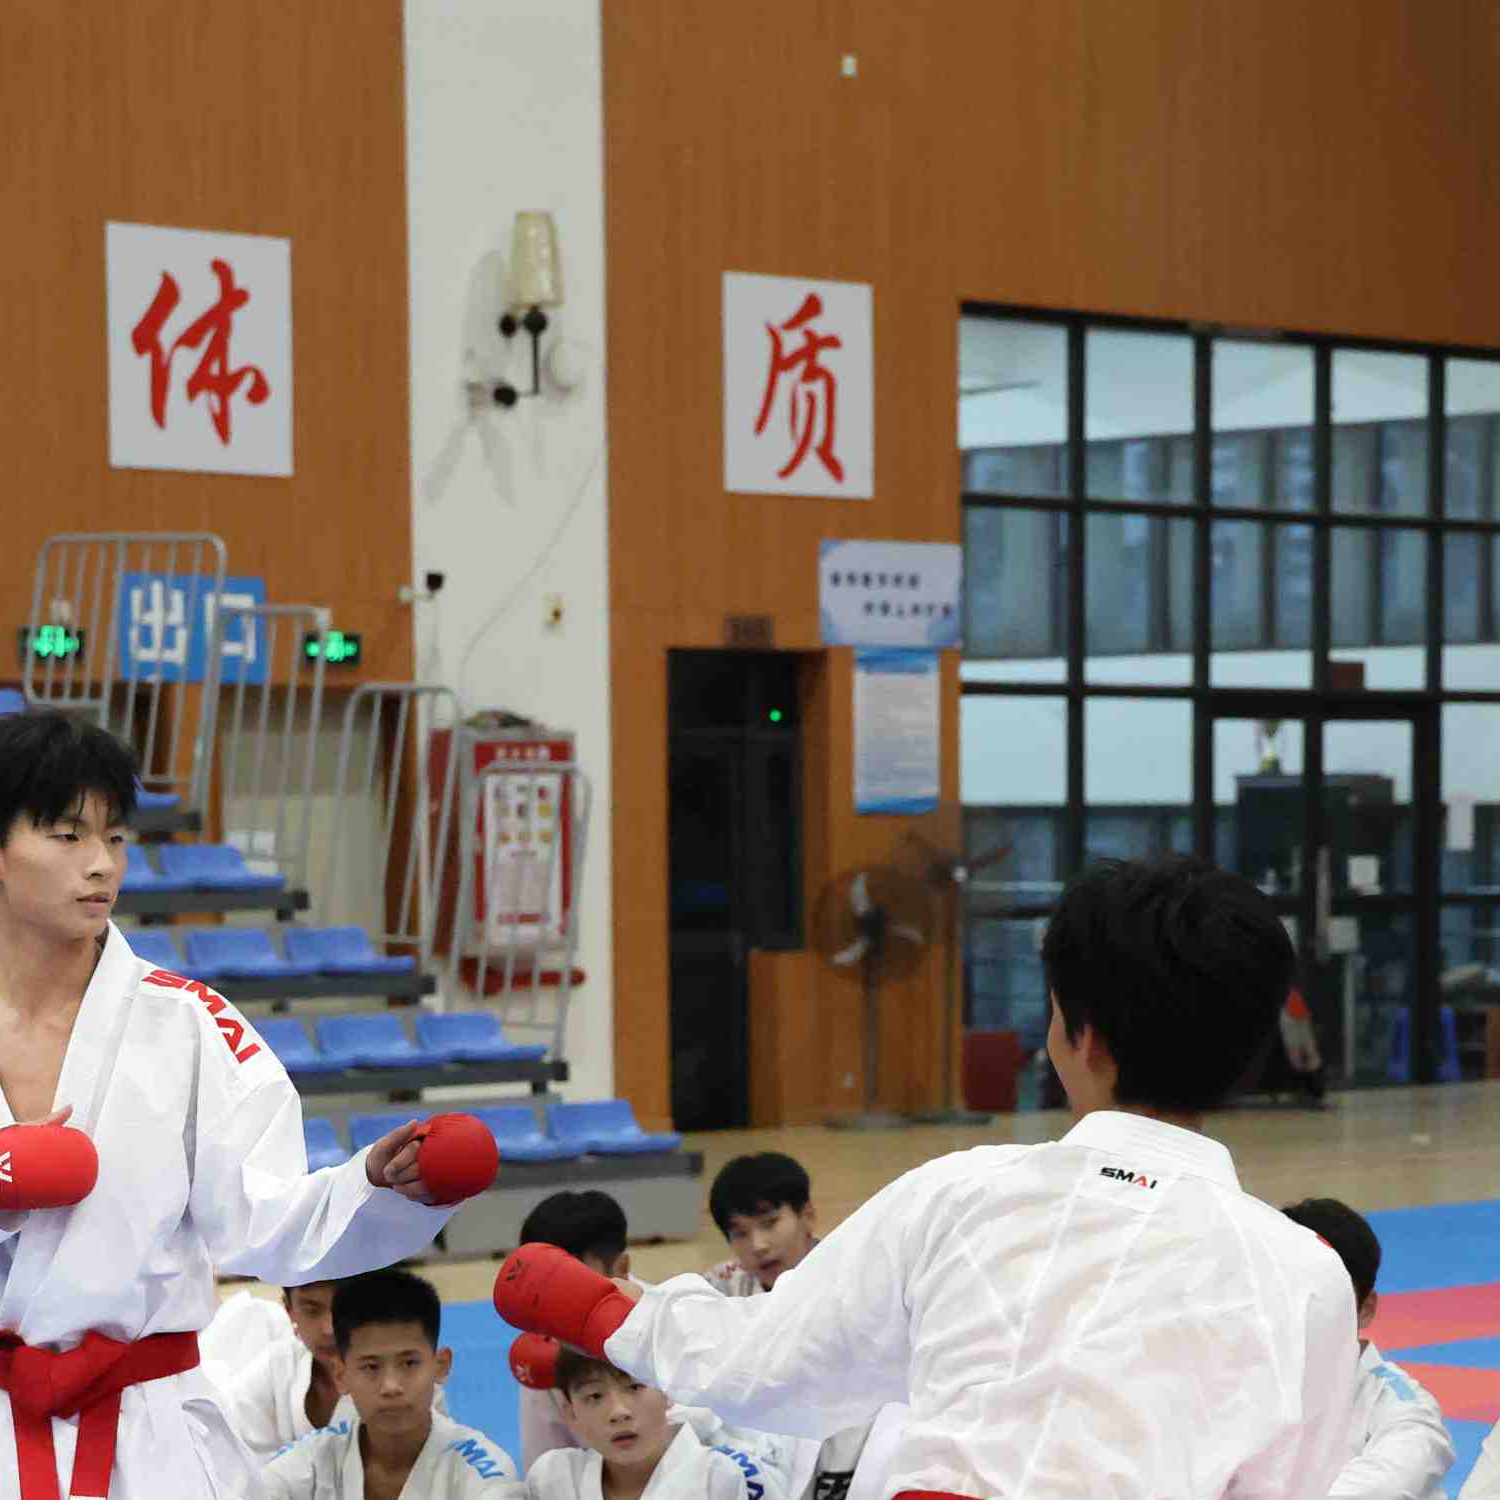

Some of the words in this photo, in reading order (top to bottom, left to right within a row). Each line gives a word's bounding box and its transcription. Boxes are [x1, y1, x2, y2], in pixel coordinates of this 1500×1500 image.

[132, 257, 269, 444] 体
[755, 293, 845, 483] 质
[129, 580, 256, 664] 出口
[141, 968, 262, 1064] SMAI
[1099, 1166, 1158, 1190] SMAI
